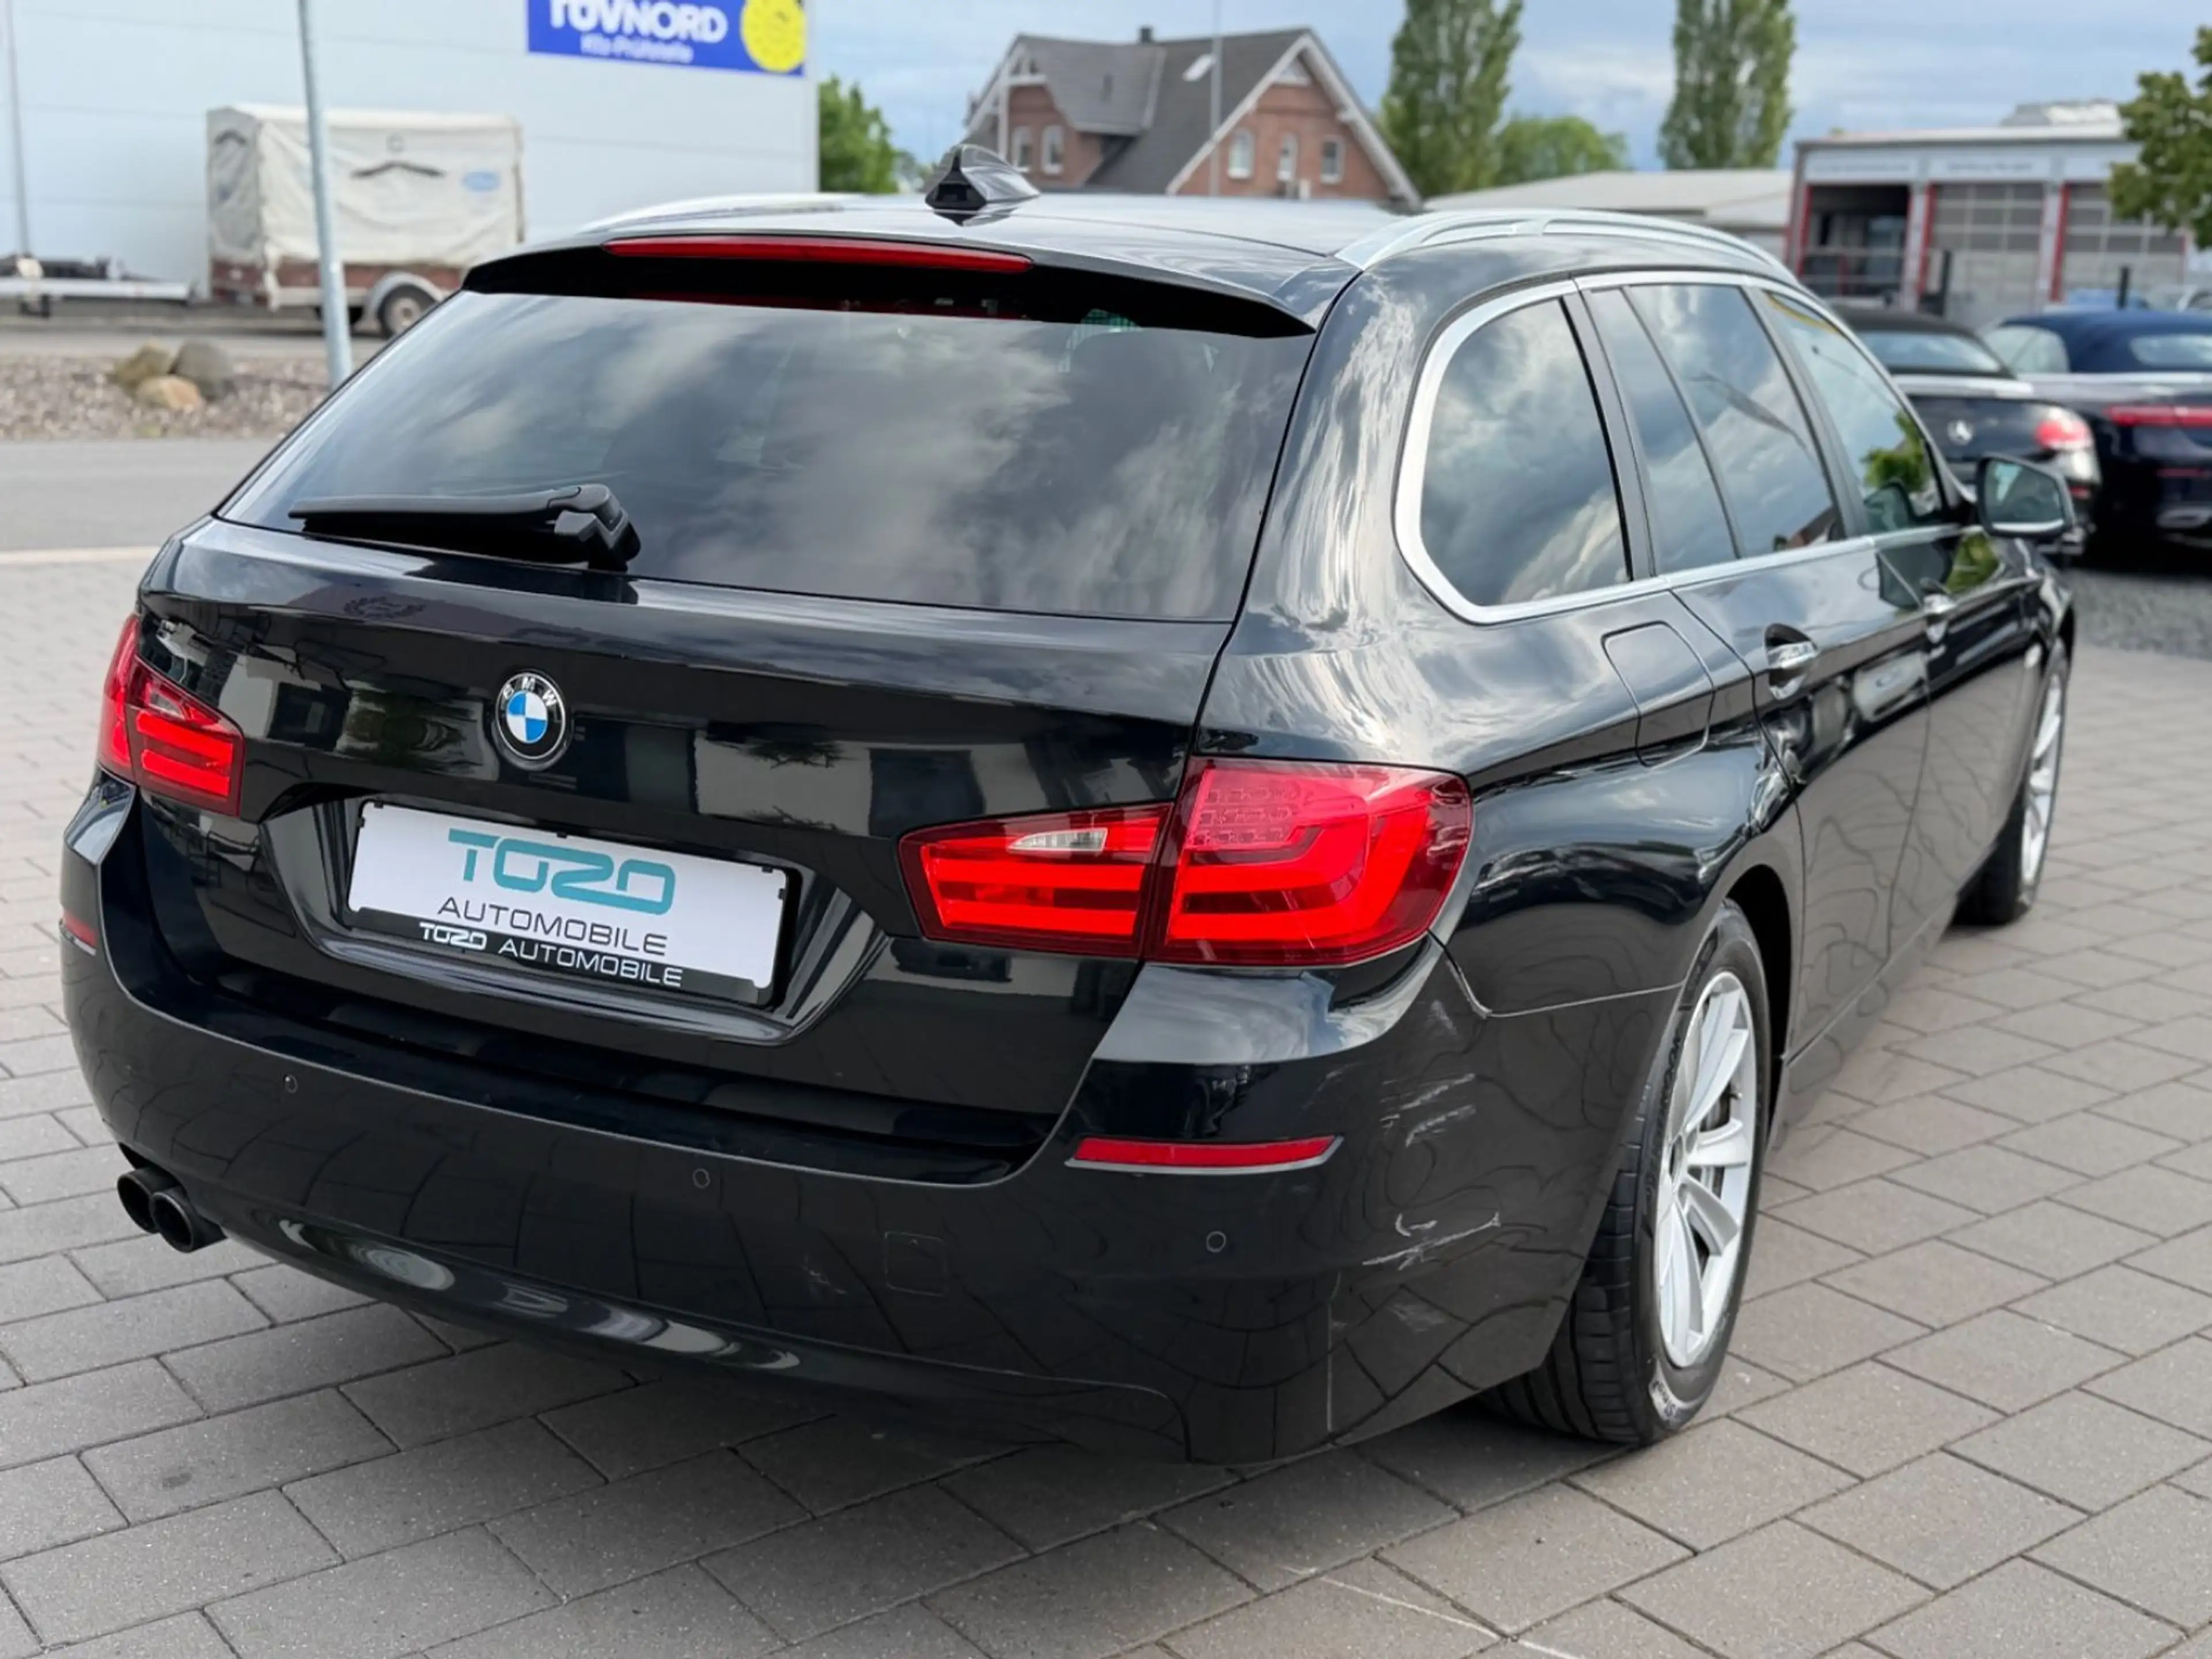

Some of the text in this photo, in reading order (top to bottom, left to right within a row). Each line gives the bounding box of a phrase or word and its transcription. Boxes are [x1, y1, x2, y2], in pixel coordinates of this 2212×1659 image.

[502, 676, 557, 707] BMW
[438, 896, 668, 957] AUTOMOBILE
[498, 938, 683, 987] AUTOMOBILE
